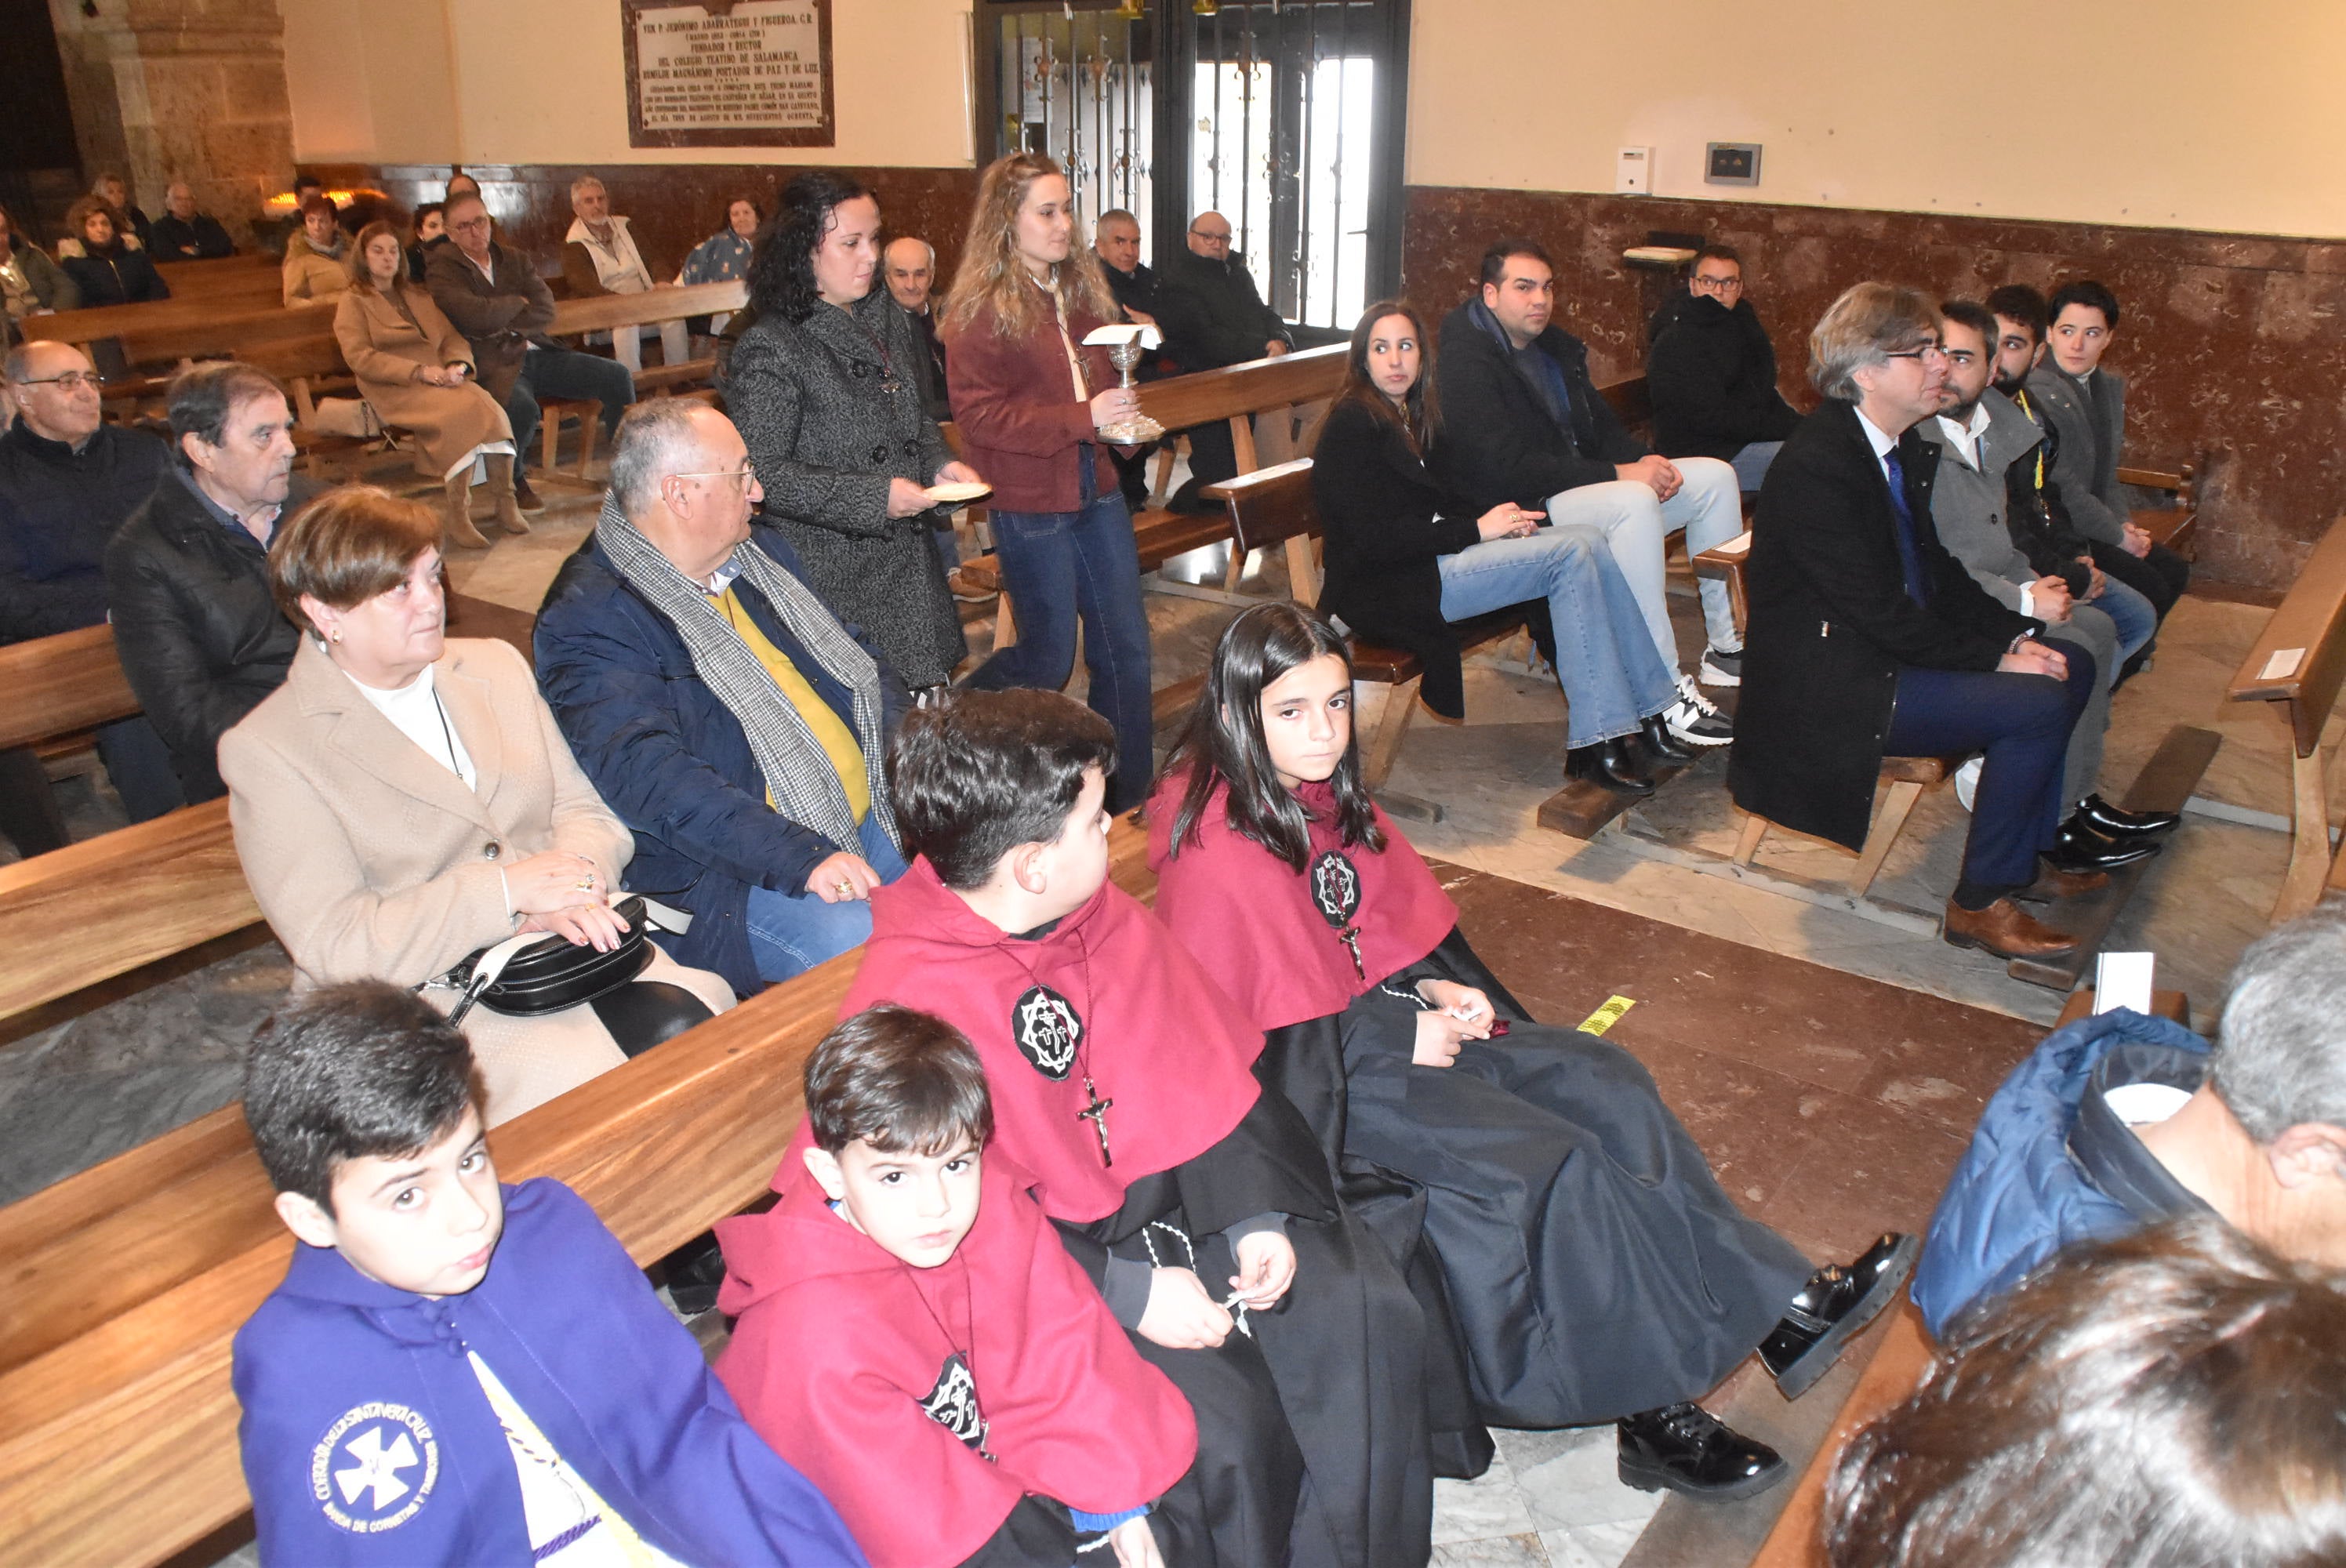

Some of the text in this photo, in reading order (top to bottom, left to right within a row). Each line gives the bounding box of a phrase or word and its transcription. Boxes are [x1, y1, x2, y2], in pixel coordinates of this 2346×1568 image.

[691, 42, 724, 53] FUNDADOR
[735, 40, 761, 50] RECTOR
[674, 56, 703, 67] COLEGIO
[706, 53, 735, 65] TEATINO
[739, 53, 748, 63] DE
[754, 51, 798, 63] SALAMANCA
[716, 65, 750, 77] PORTADOR
[754, 65, 762, 75] DE
[766, 64, 780, 75] PAZ
[793, 64, 801, 74] DE
[381, 1403, 410, 1421] VERA
[405, 1411, 433, 1444] CRUZ
[352, 1520, 368, 1533] DE
